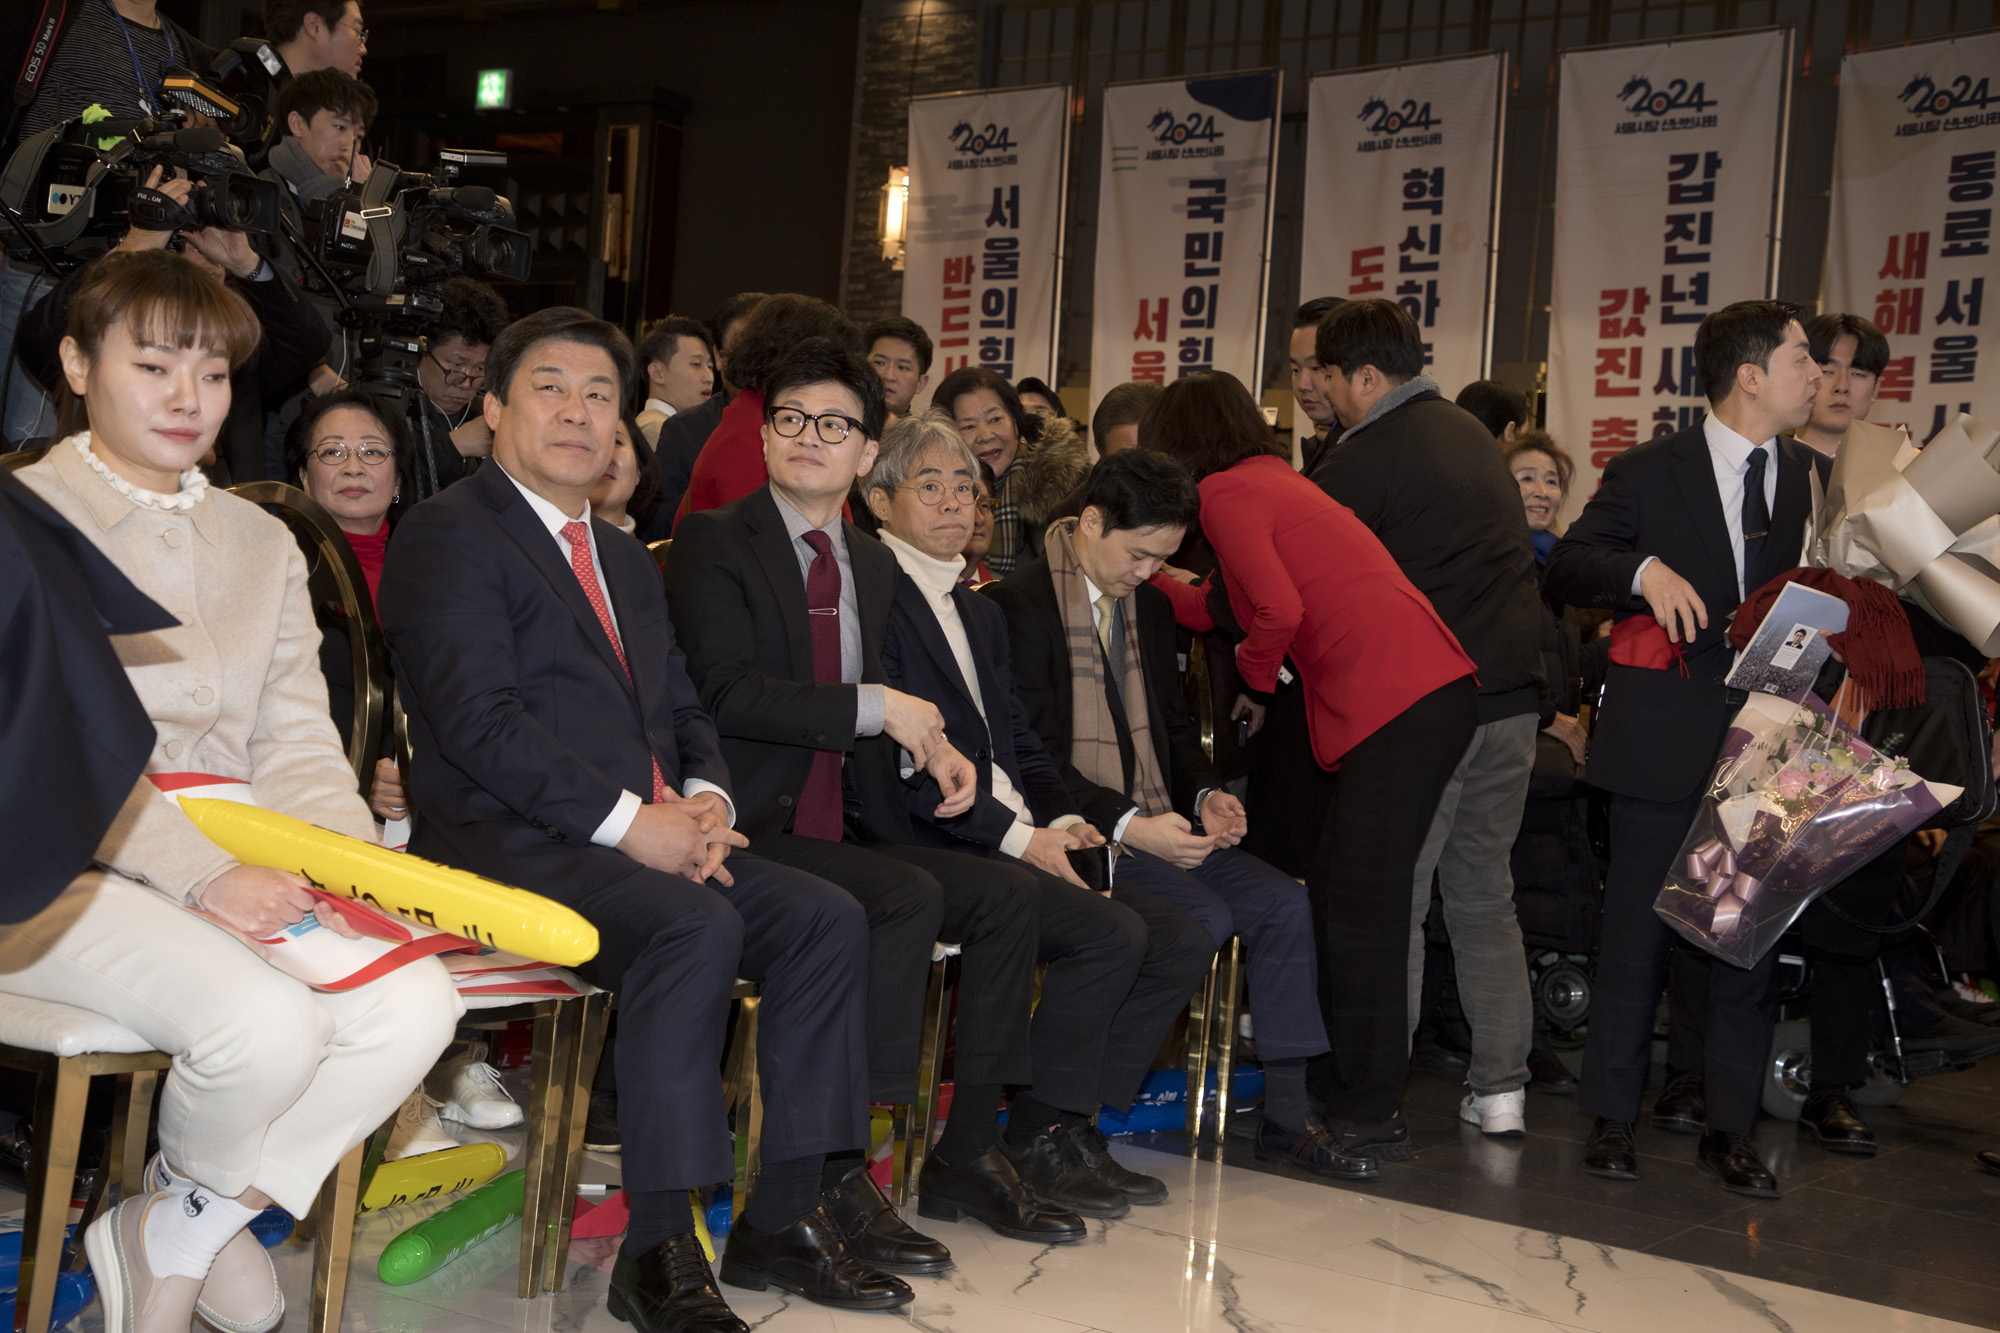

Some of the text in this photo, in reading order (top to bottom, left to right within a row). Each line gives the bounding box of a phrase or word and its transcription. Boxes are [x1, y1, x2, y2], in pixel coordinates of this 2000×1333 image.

[25, 56, 41, 82] EOS
[35, 41, 47, 56] 5D
[42, 24, 54, 41] Mark
[1357, 97, 1443, 136] 2024
[1616, 75, 1718, 117] 2024
[1897, 73, 2000, 117] 2024
[948, 120, 1018, 155] 2024
[1147, 108, 1225, 146] 2024
[1940, 150, 1997, 258] 동료
[1396, 167, 1445, 366] 혁신하
[1659, 151, 1722, 325] 갑진년
[1177, 178, 1227, 378] 국민의힘
[1873, 231, 1930, 336] 새해
[1588, 287, 1650, 502] 값진 총
[1832, 827, 1877, 859] Nazane
